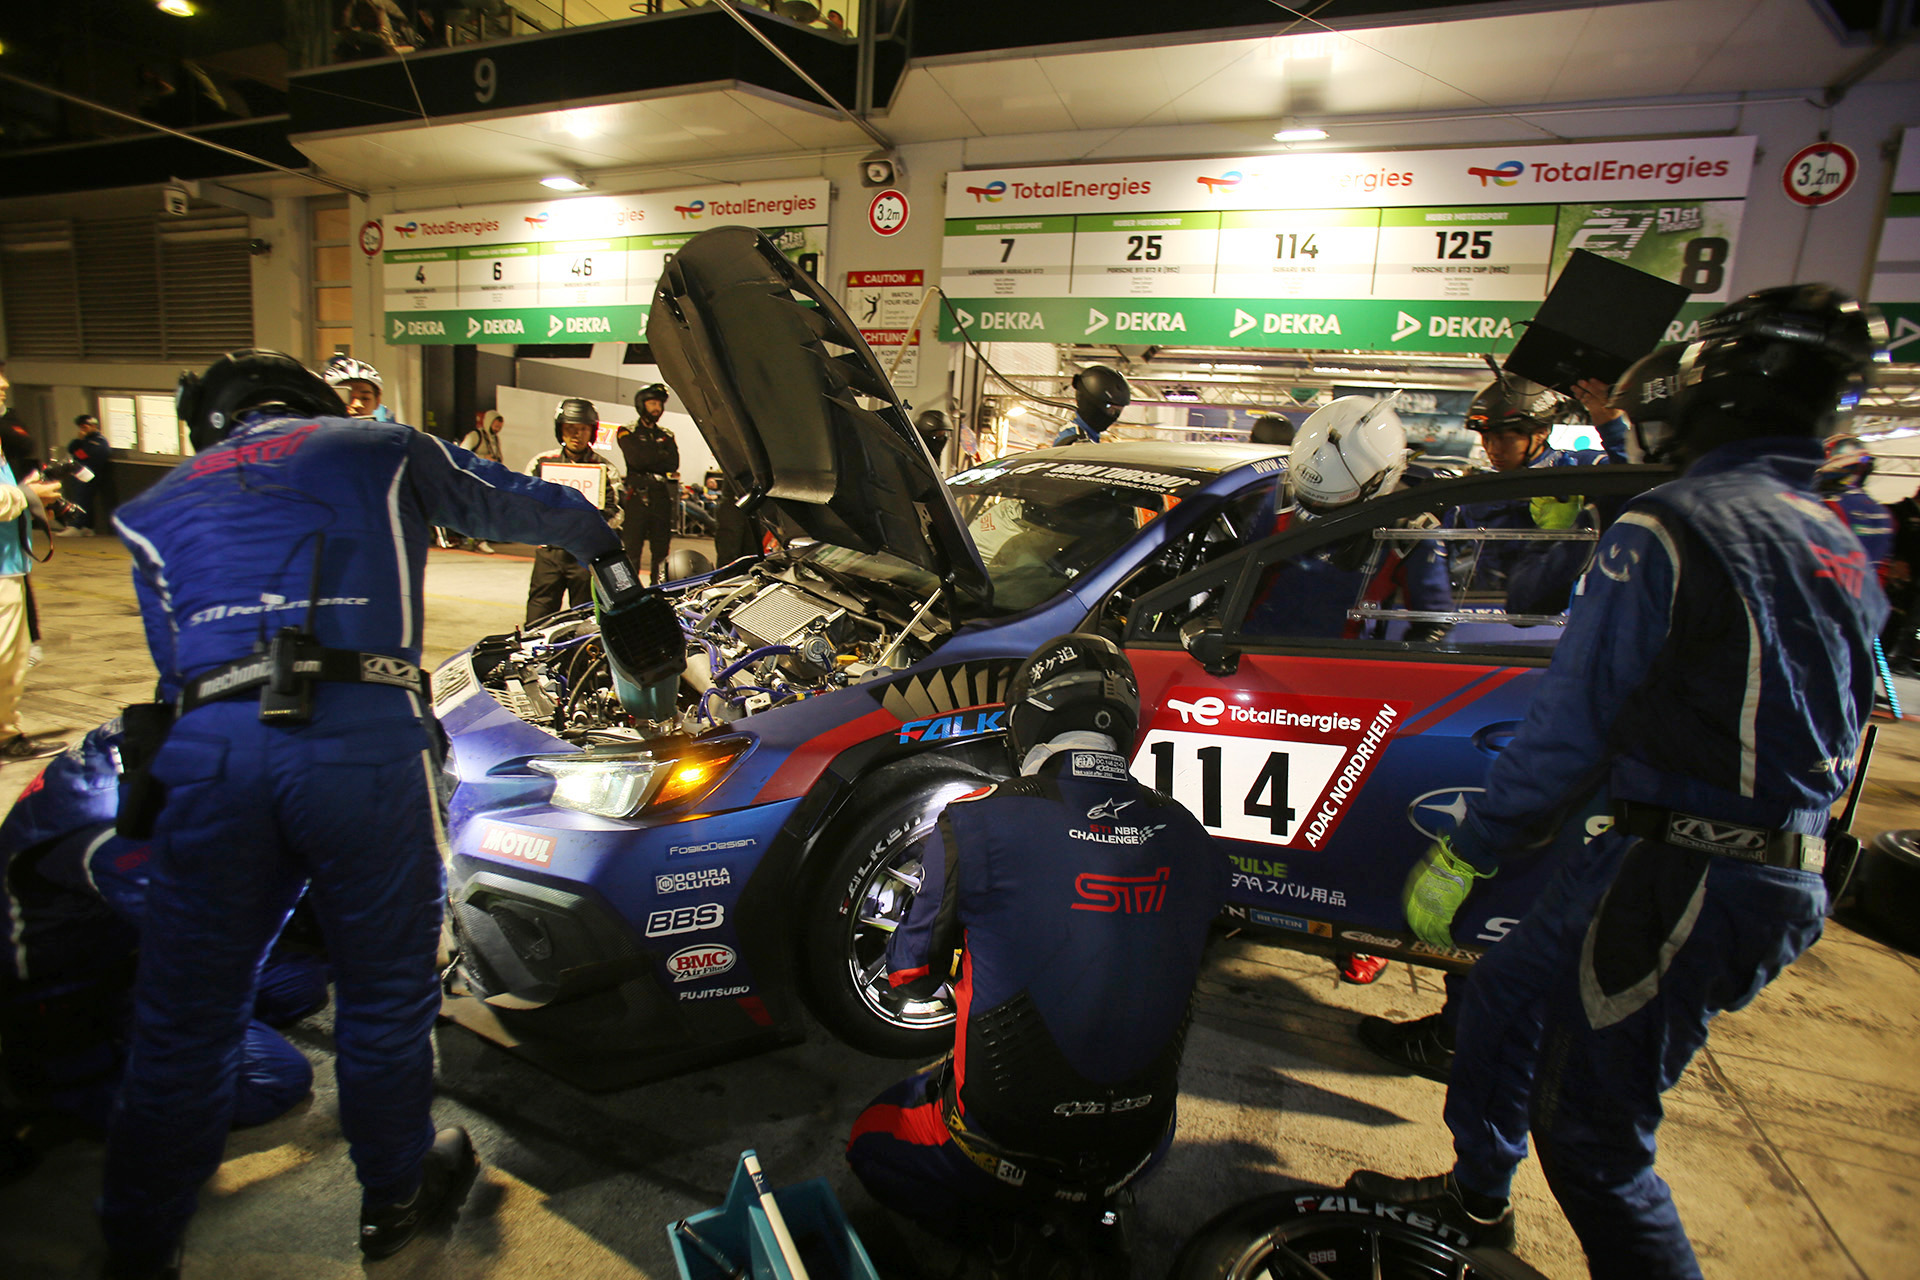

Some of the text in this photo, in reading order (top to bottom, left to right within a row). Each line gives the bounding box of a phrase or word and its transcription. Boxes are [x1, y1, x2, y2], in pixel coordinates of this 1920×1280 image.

[474, 57, 496, 103] 9
[1531, 156, 1729, 184] TotalEnergies
[1011, 178, 1151, 200] TotalEnergies
[708, 195, 817, 216] TotalEnergies
[419, 219, 500, 236] TotalEnergies
[1000, 238, 1016, 263] 7
[1126, 235, 1163, 261] 25
[1275, 233, 1319, 259] 114
[1435, 230, 1493, 260] 125
[415, 265, 426, 285] 4
[493, 261, 502, 281] 6
[571, 257, 592, 277] 46
[1681, 237, 1729, 294] 8
[863, 273, 906, 284] CAUTION
[407, 322, 446, 336] DEKRA
[483, 319, 525, 335] DEKRA
[566, 317, 611, 333] DEKRA
[980, 311, 1045, 330] DEKRA
[1115, 311, 1187, 331] DEKRA
[1263, 313, 1342, 335] DEKRA
[1428, 316, 1514, 339] DEKRA
[864, 332, 907, 343] CHTUNG
[1103, 467, 1192, 488] TURISMO
[894, 710, 1006, 745] FALK
[1227, 704, 1362, 733] TotalEnergies
[1304, 702, 1398, 848] ADAC NORDRHEIN
[1150, 740, 1296, 837] 114
[1069, 829, 1139, 845] CHALLENGE
[1090, 824, 1139, 835] STI NBR
[482, 829, 551, 863] MOTUL
[675, 867, 730, 882] OGURA
[676, 876, 731, 891] CLUTCH
[646, 903, 725, 938] BBS
[1256, 913, 1302, 929] BILSTEIN
[675, 951, 728, 970] BMC
[679, 970, 702, 979] Air
[680, 986, 750, 1000] FUJITSUBO
